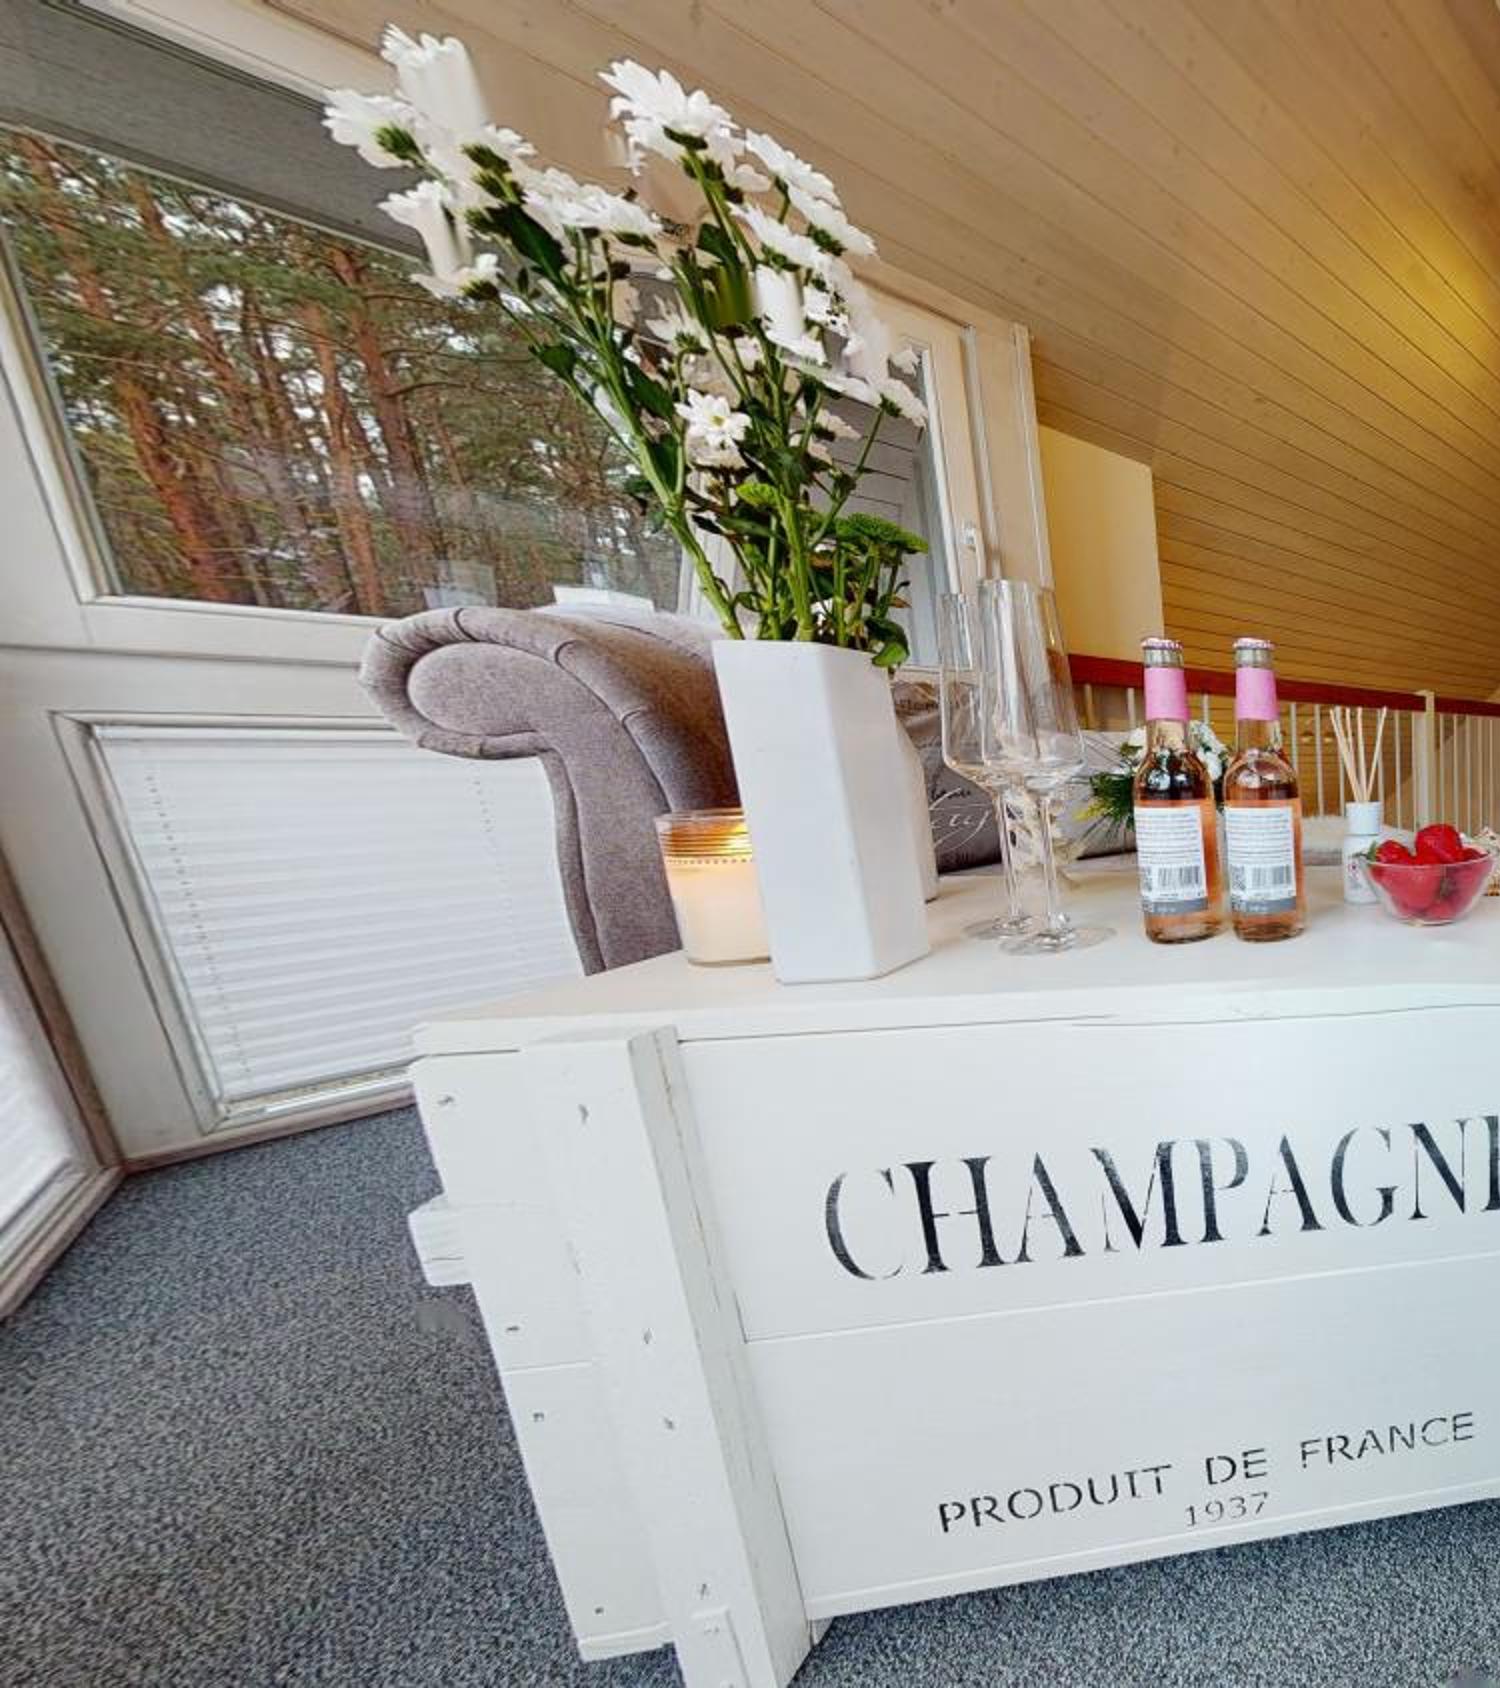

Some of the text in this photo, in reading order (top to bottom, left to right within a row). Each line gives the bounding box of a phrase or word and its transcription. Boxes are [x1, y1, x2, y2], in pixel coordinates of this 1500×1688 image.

[937, 1411, 1476, 1534] PRODUIT DE FRANCE
[1184, 1491, 1270, 1529] 1937
